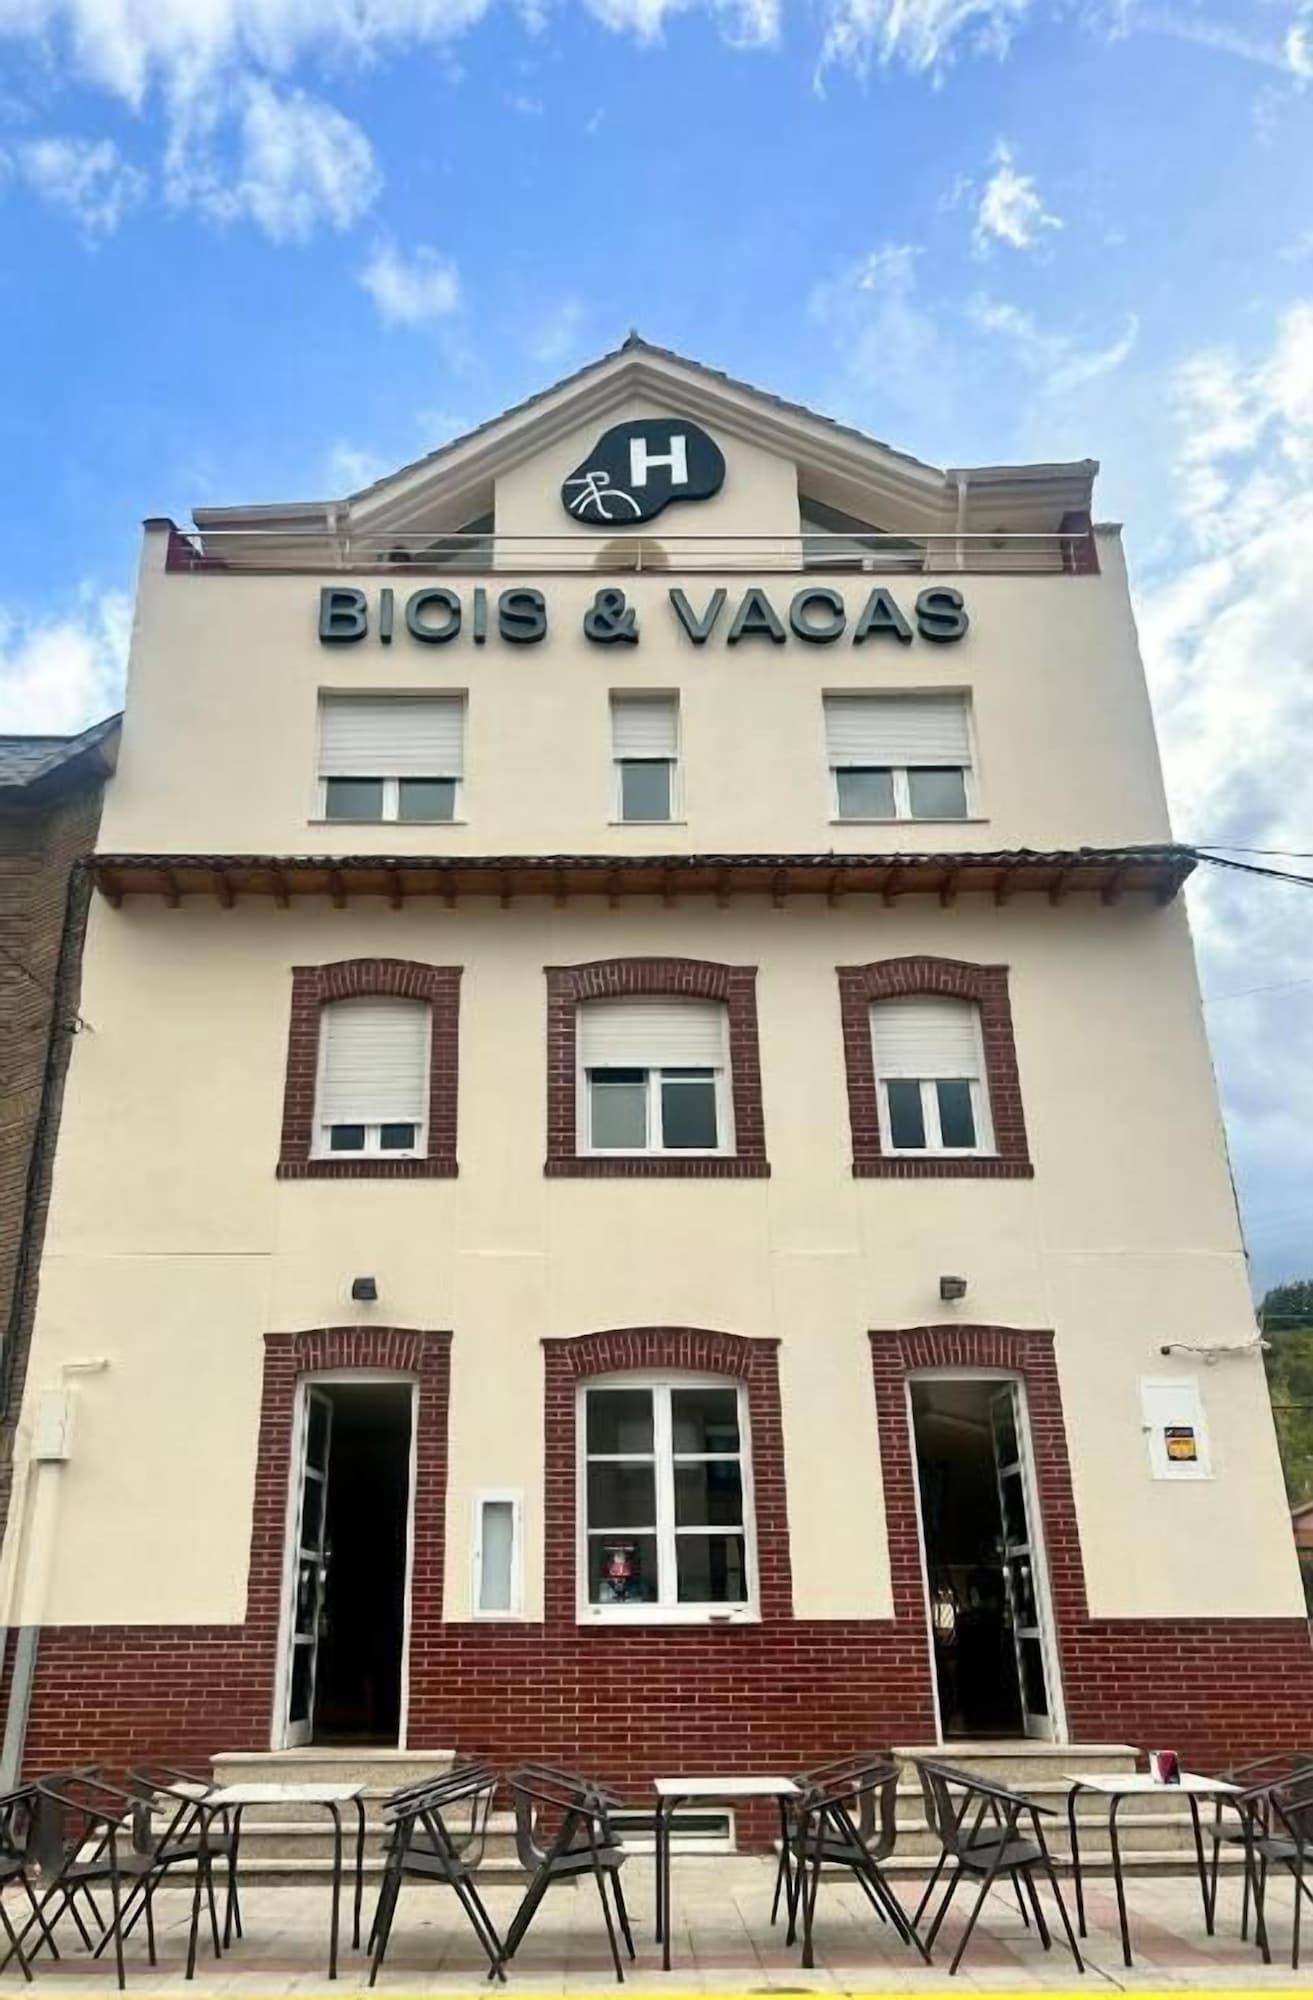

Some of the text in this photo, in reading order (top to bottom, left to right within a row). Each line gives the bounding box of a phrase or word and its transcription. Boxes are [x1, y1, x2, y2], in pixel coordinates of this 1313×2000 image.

[629, 434, 689, 488] H
[318, 587, 970, 646] BICIS & VACAS
